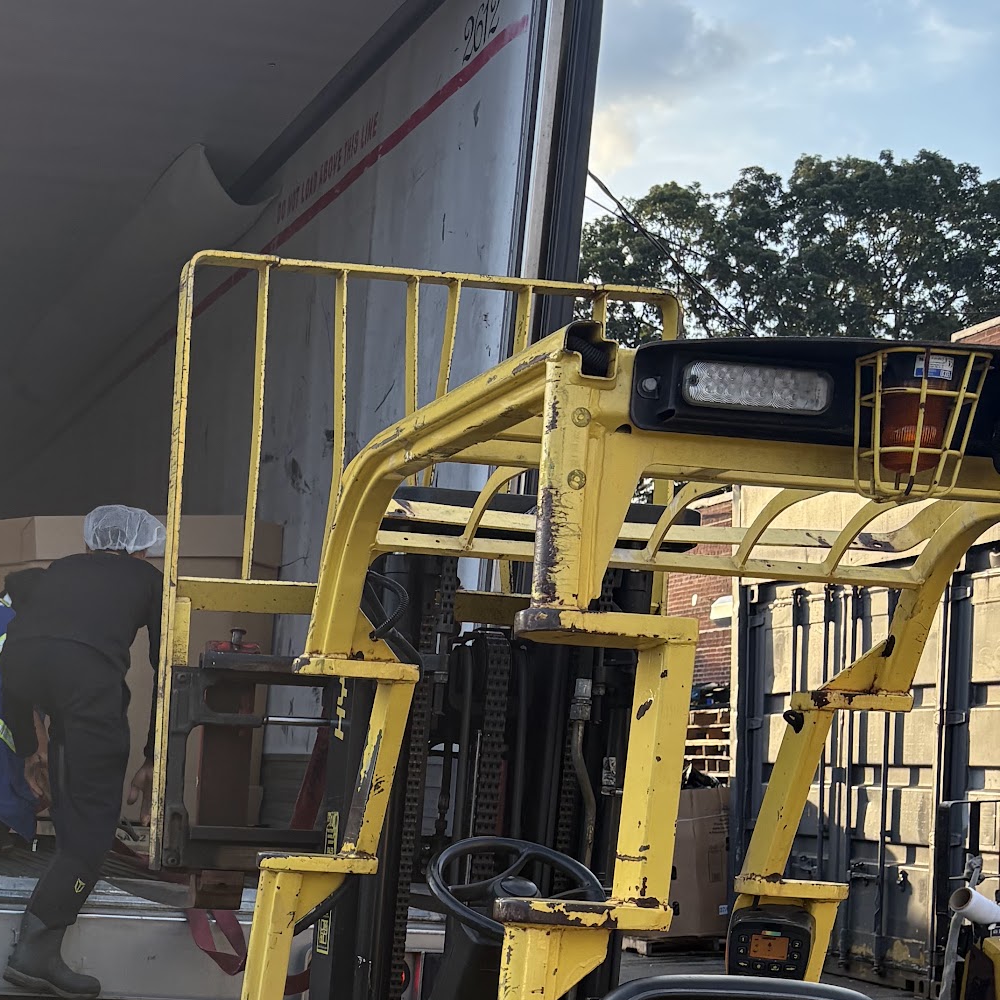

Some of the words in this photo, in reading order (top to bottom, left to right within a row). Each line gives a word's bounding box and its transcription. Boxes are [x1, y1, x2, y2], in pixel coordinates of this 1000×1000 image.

[319, 147, 342, 185] ABOVE
[344, 130, 360, 165] THIS
[360, 111, 379, 149] LINE
